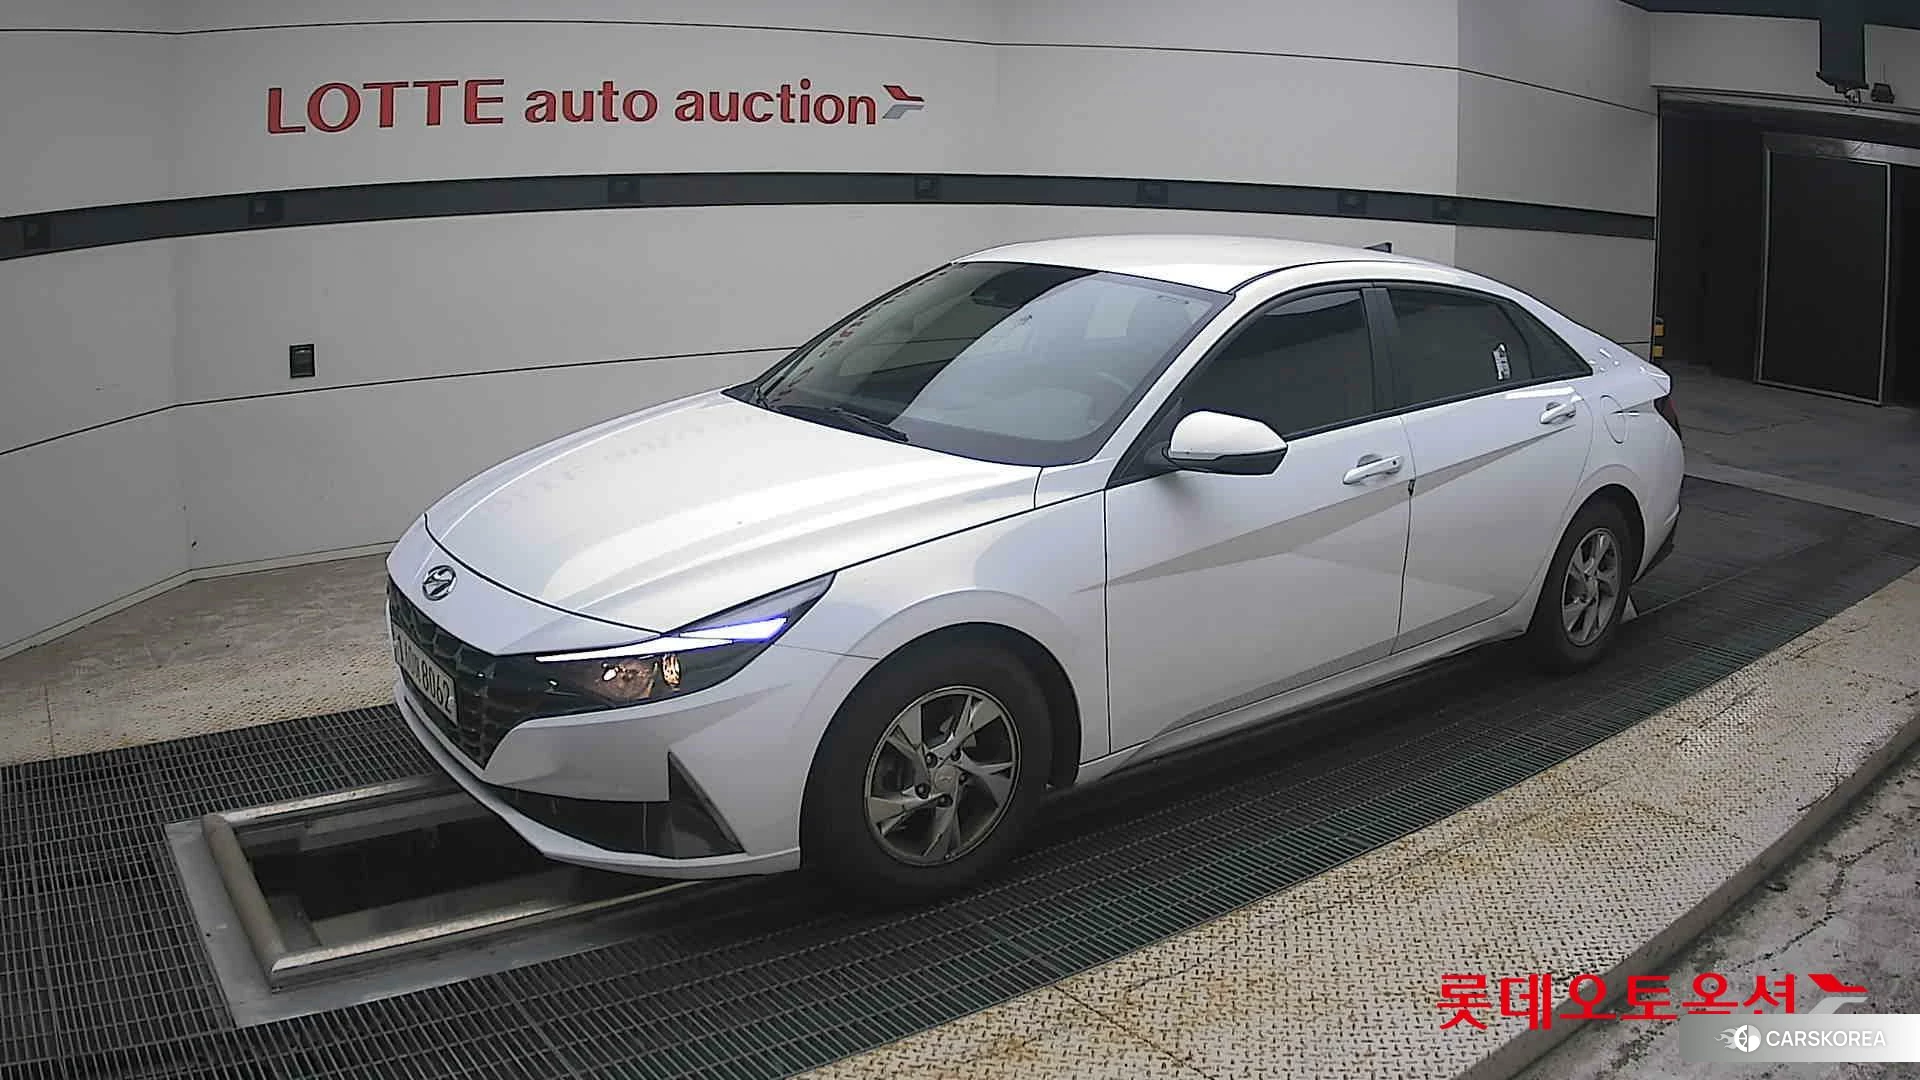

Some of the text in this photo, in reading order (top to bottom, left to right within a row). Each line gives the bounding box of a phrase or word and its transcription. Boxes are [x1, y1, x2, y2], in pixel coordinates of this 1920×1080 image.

[267, 78, 877, 134] LOTTE auto auction
